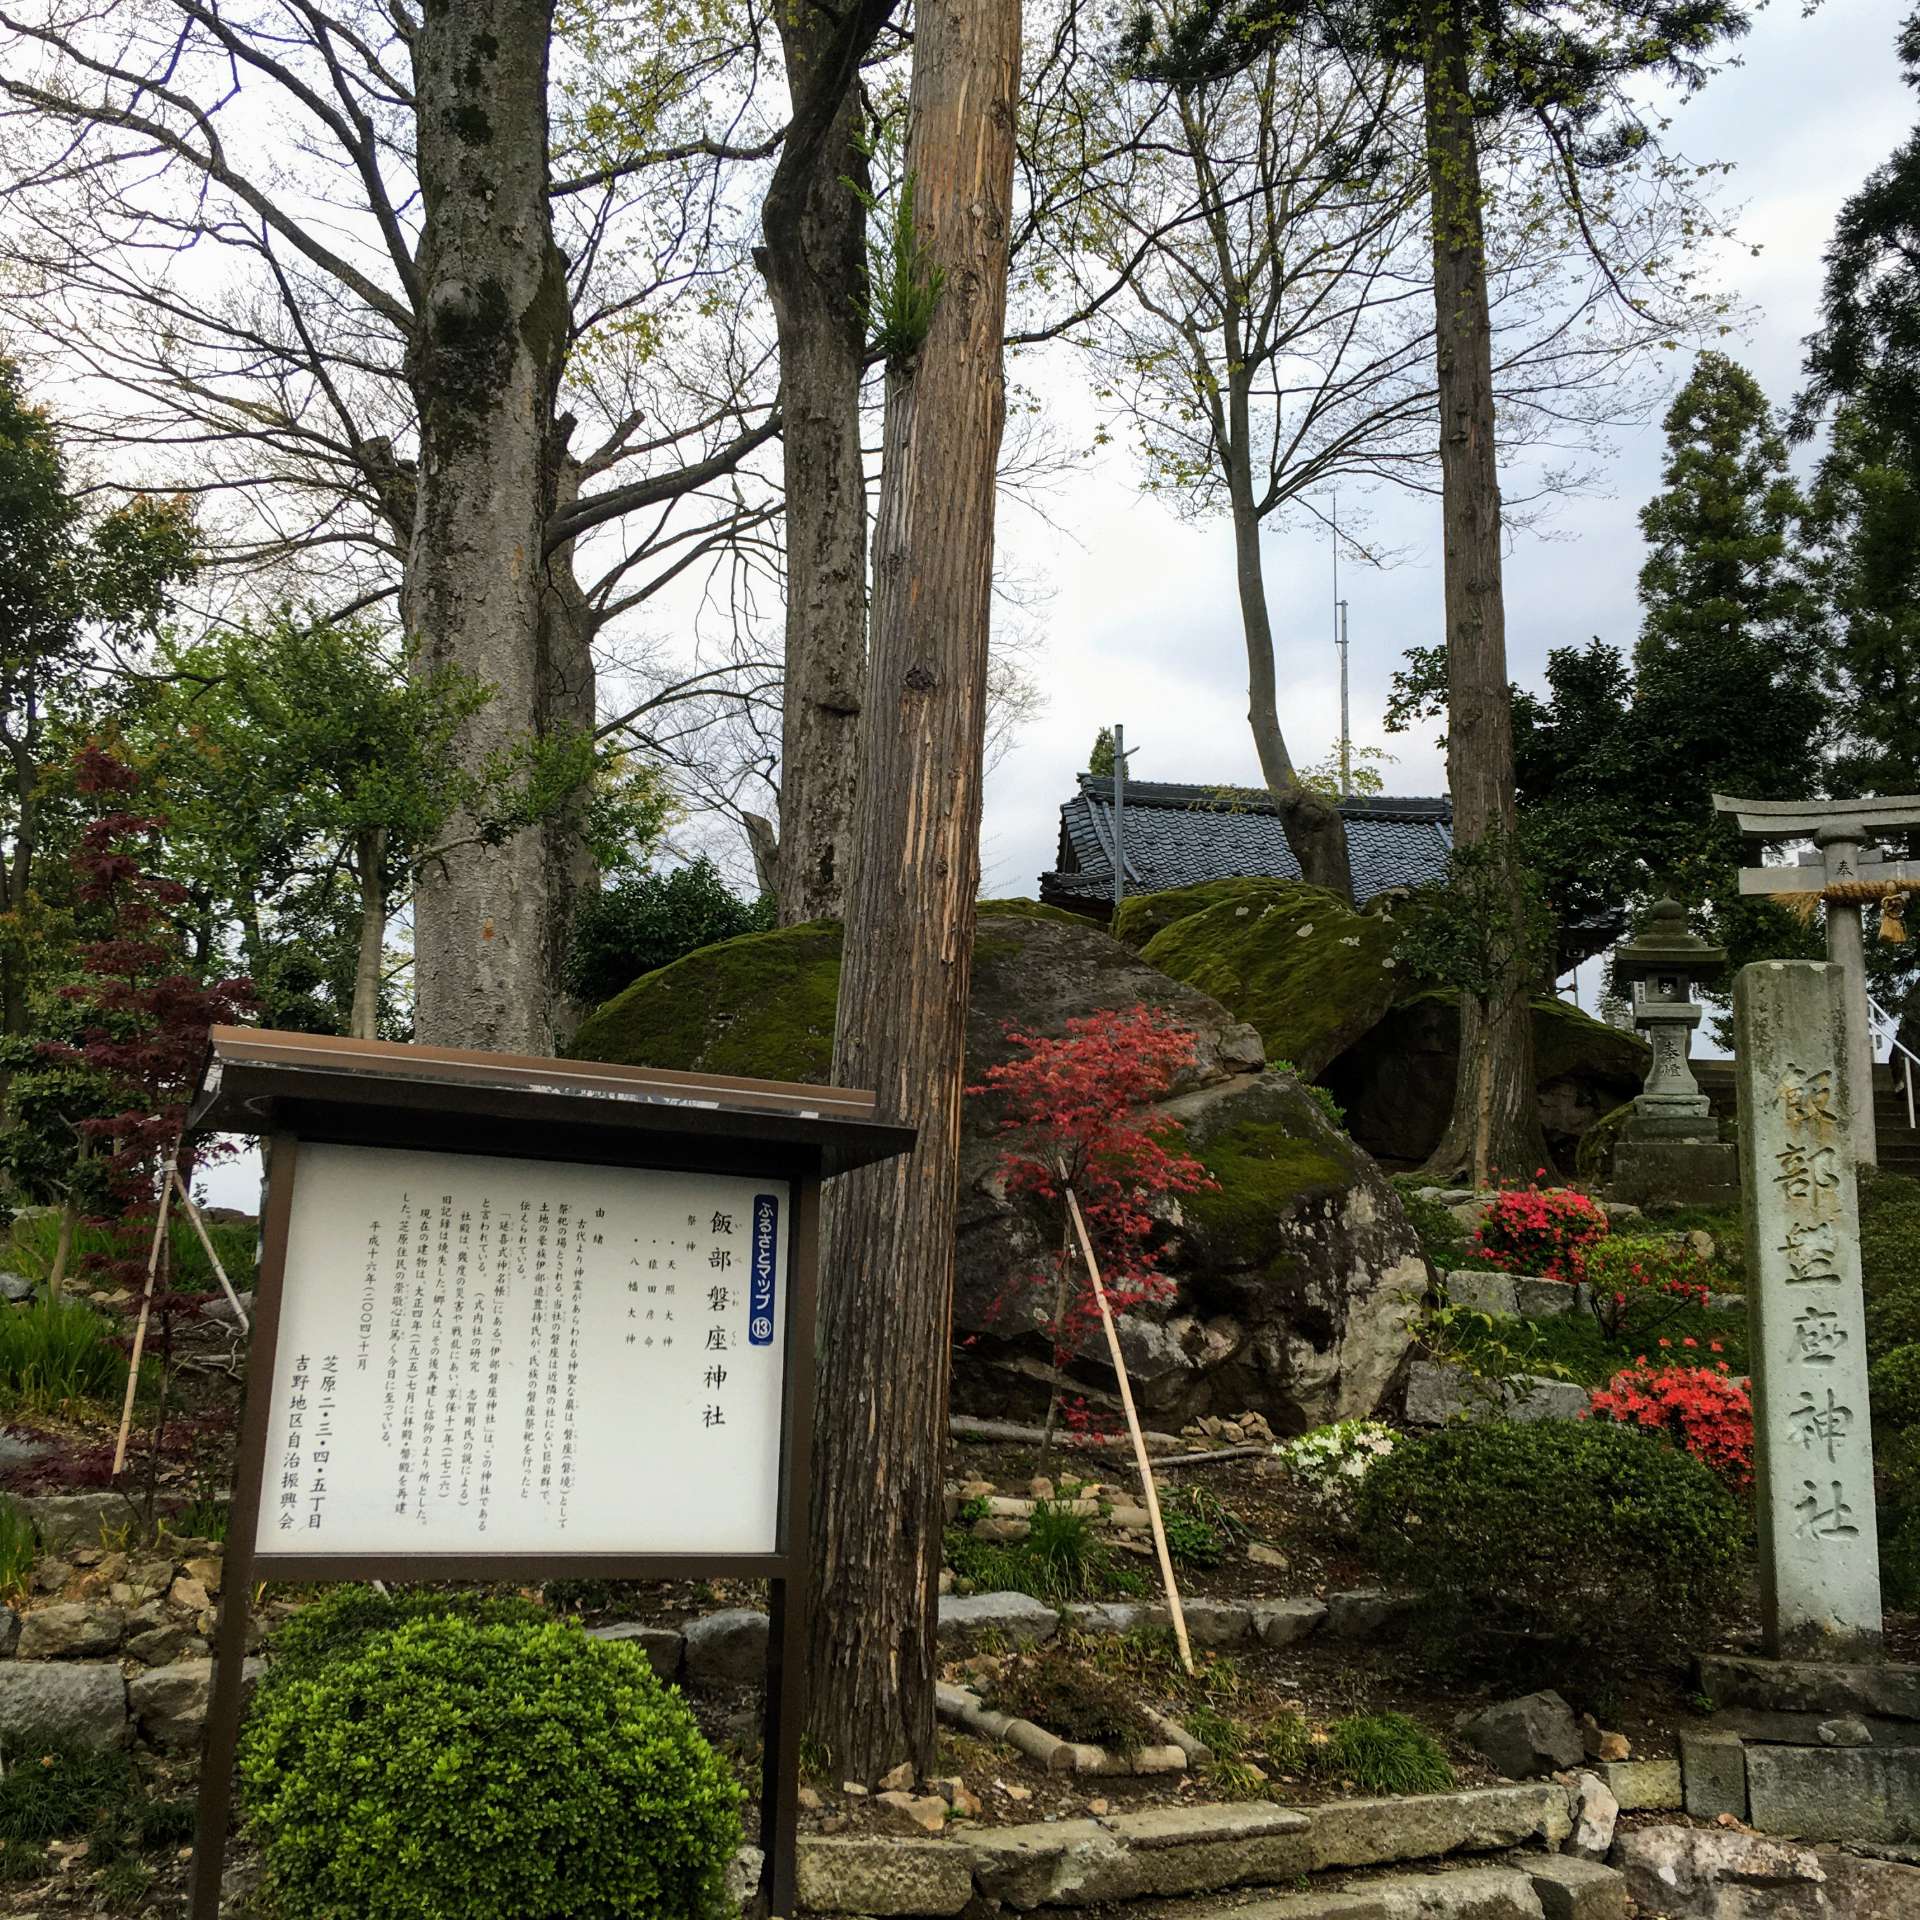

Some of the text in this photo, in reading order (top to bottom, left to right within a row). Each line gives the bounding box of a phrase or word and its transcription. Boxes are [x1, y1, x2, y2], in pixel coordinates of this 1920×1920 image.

[1836, 860, 1853, 877] 奉
[592, 1207, 606, 1245] 由緒
[703, 1210, 733, 1429] 飯部磐座神社
[279, 1354, 311, 1530] 吉野地区自治振興会
